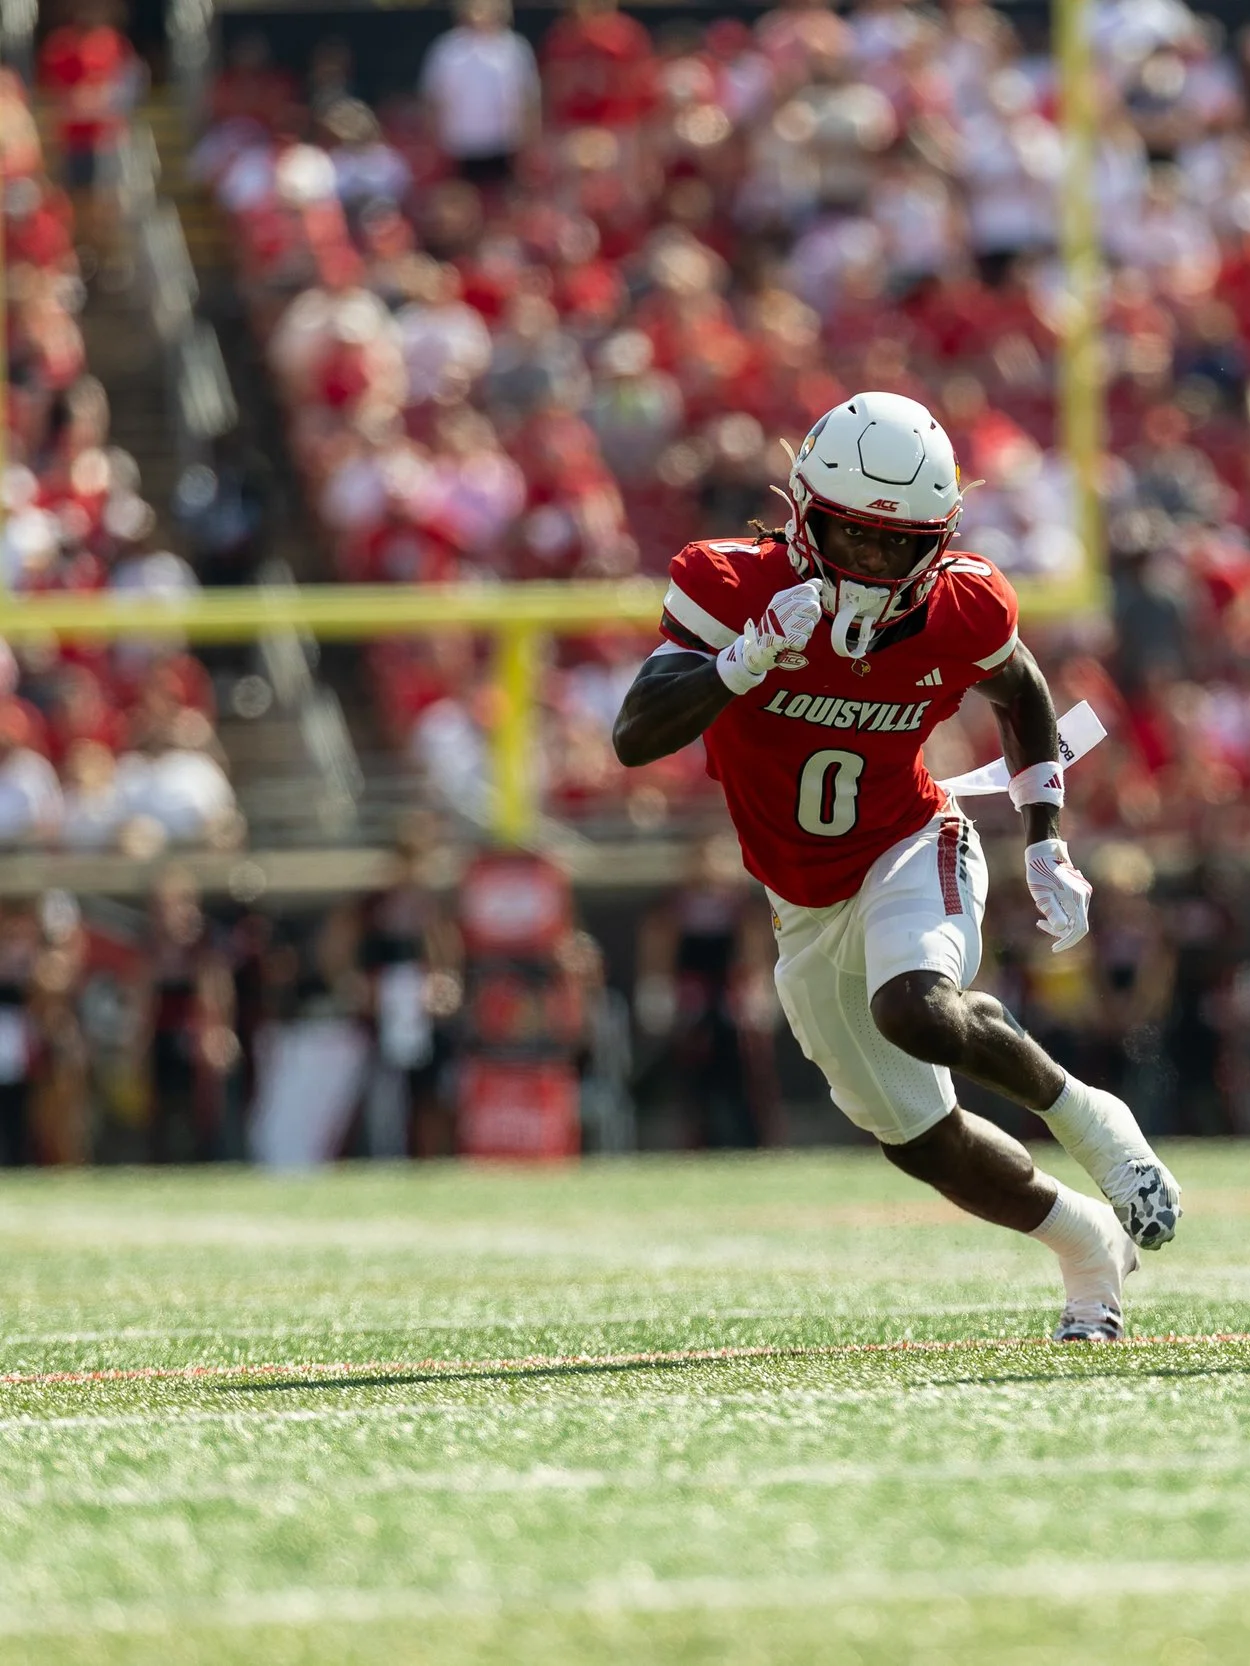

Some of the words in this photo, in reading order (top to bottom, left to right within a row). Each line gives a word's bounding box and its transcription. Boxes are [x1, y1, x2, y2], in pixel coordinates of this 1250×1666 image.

[866, 499, 900, 512] ACC
[762, 689, 932, 732] LOUISVILLE
[797, 748, 865, 837] 0
